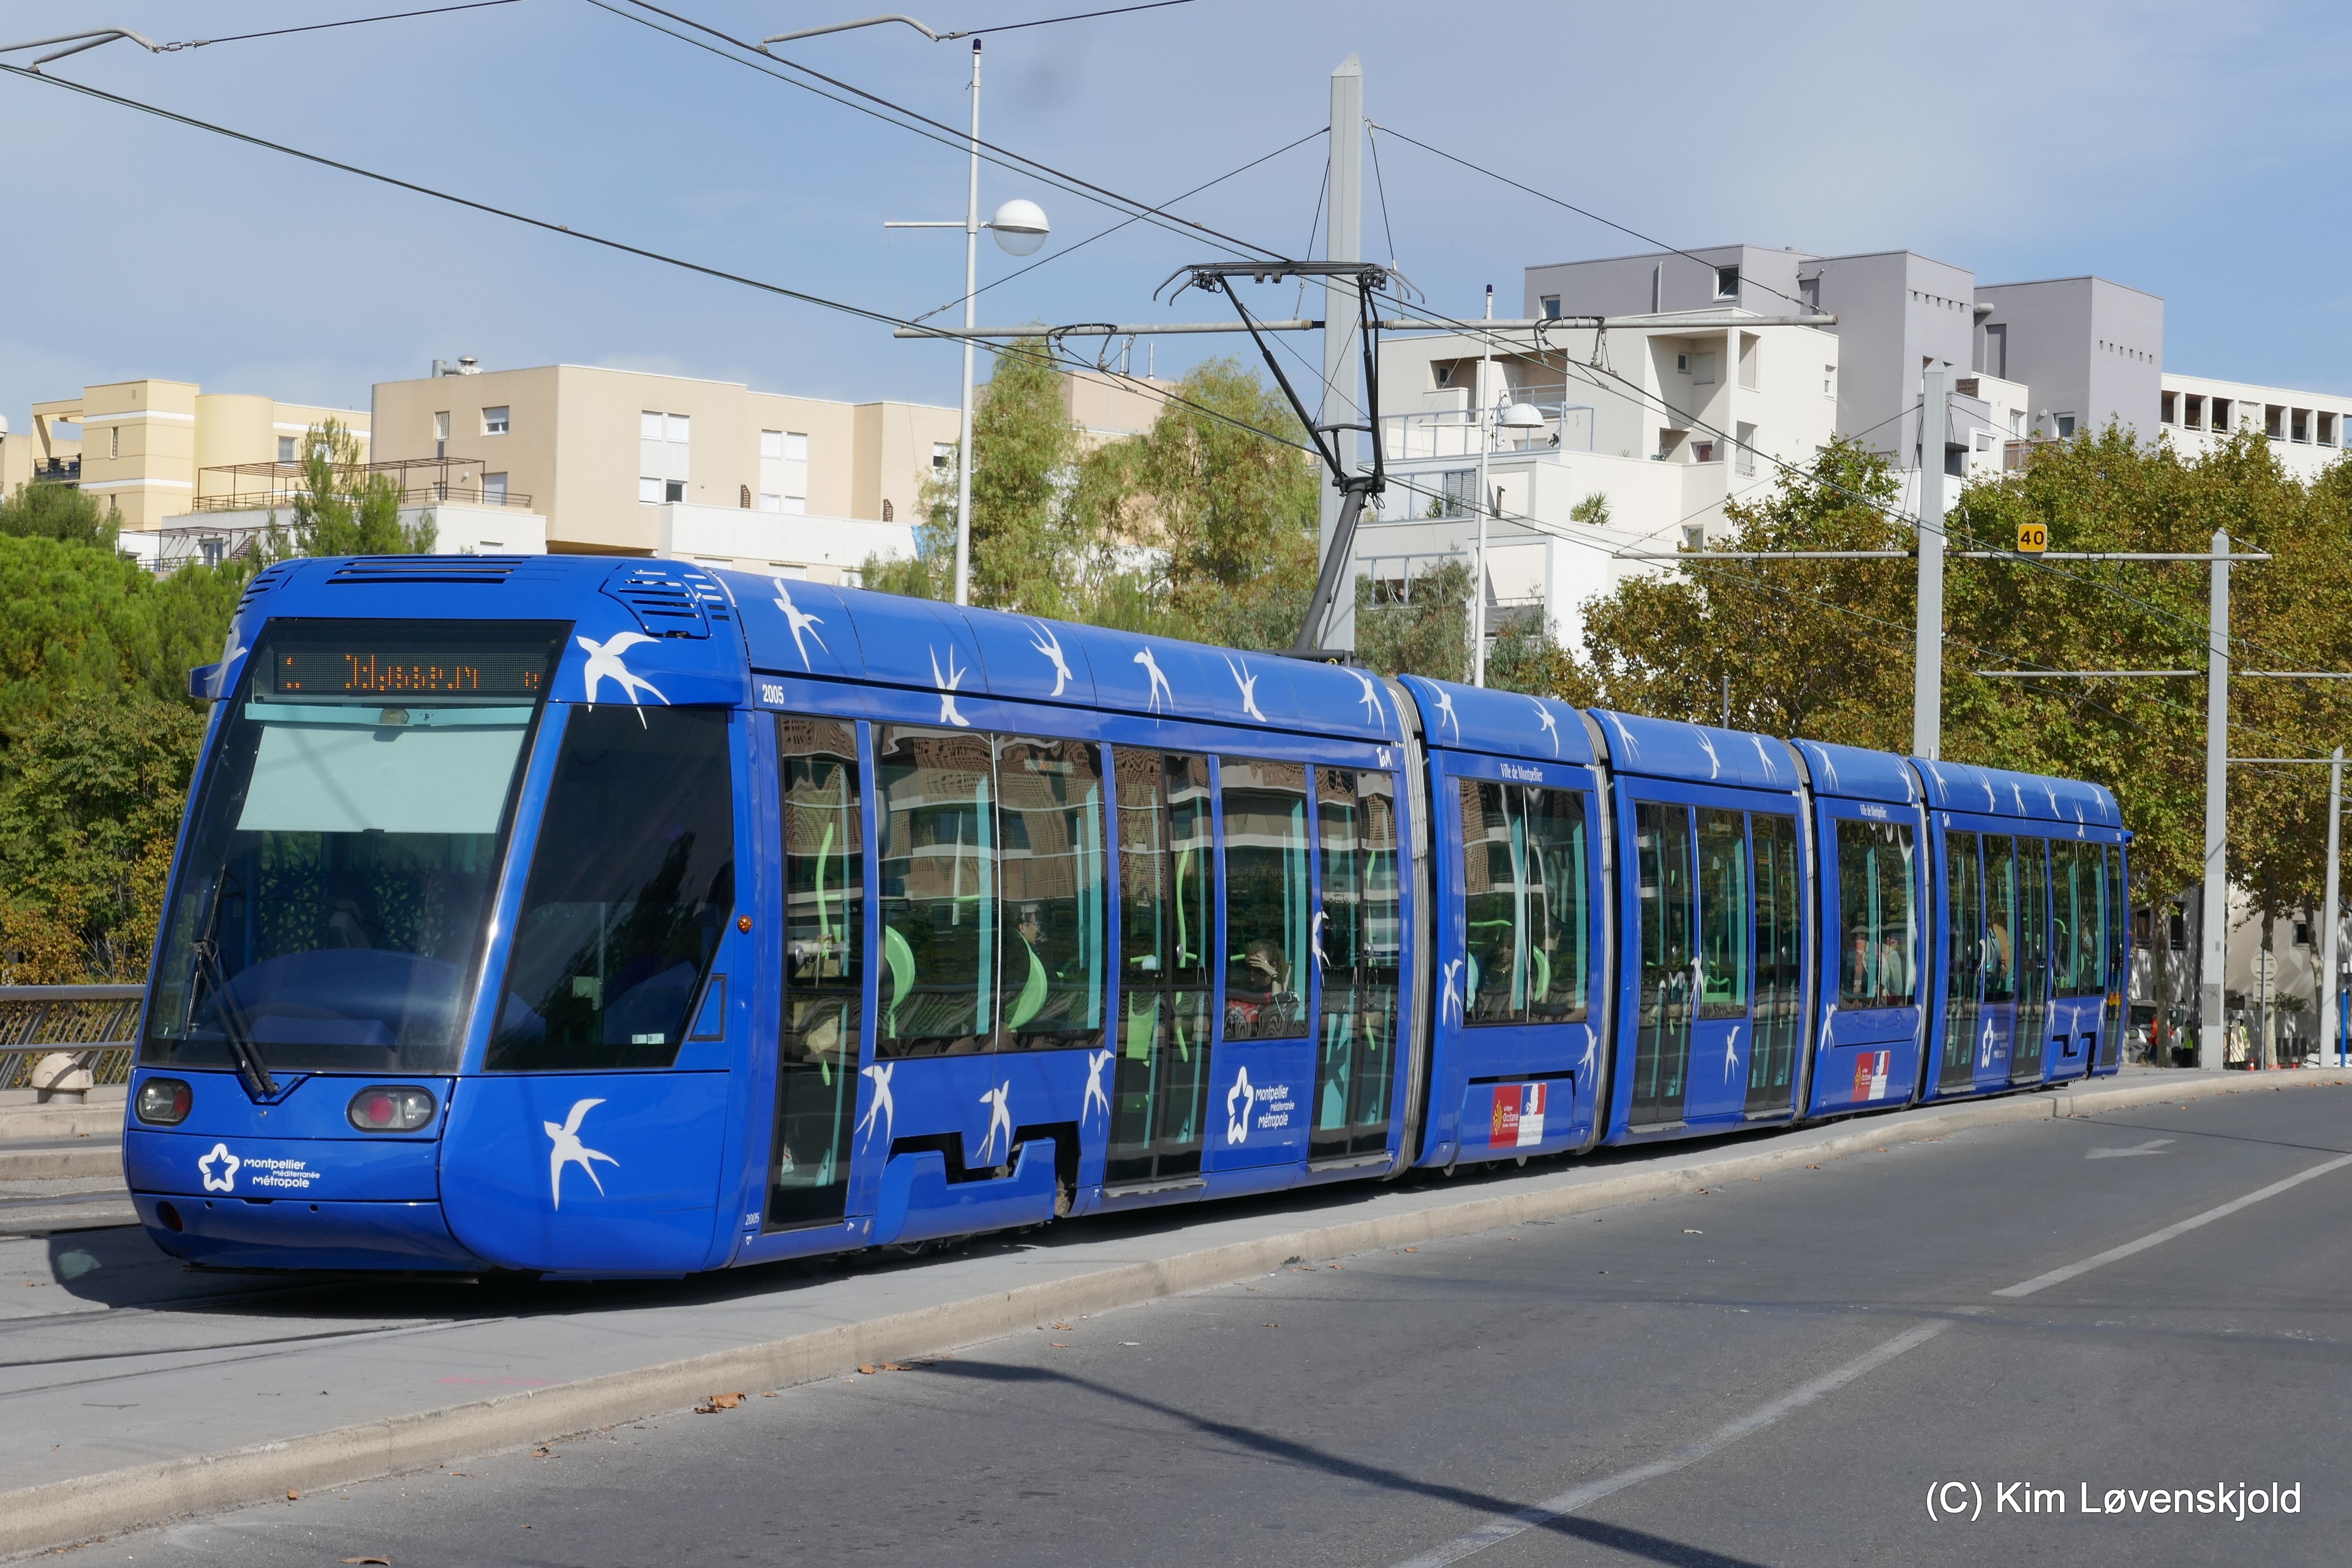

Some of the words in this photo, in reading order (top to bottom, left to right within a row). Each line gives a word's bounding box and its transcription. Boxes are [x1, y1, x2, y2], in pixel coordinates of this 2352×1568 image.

[2020, 530, 2045, 545] 40
[762, 684, 784, 704] 2005
[1500, 763, 1512, 778] Ville
[1512, 764, 1518, 780] de
[1518, 765, 1543, 783] Montpellier
[1502, 1111, 1519, 1122] Occitanie
[745, 1213, 760, 1226] 2005
